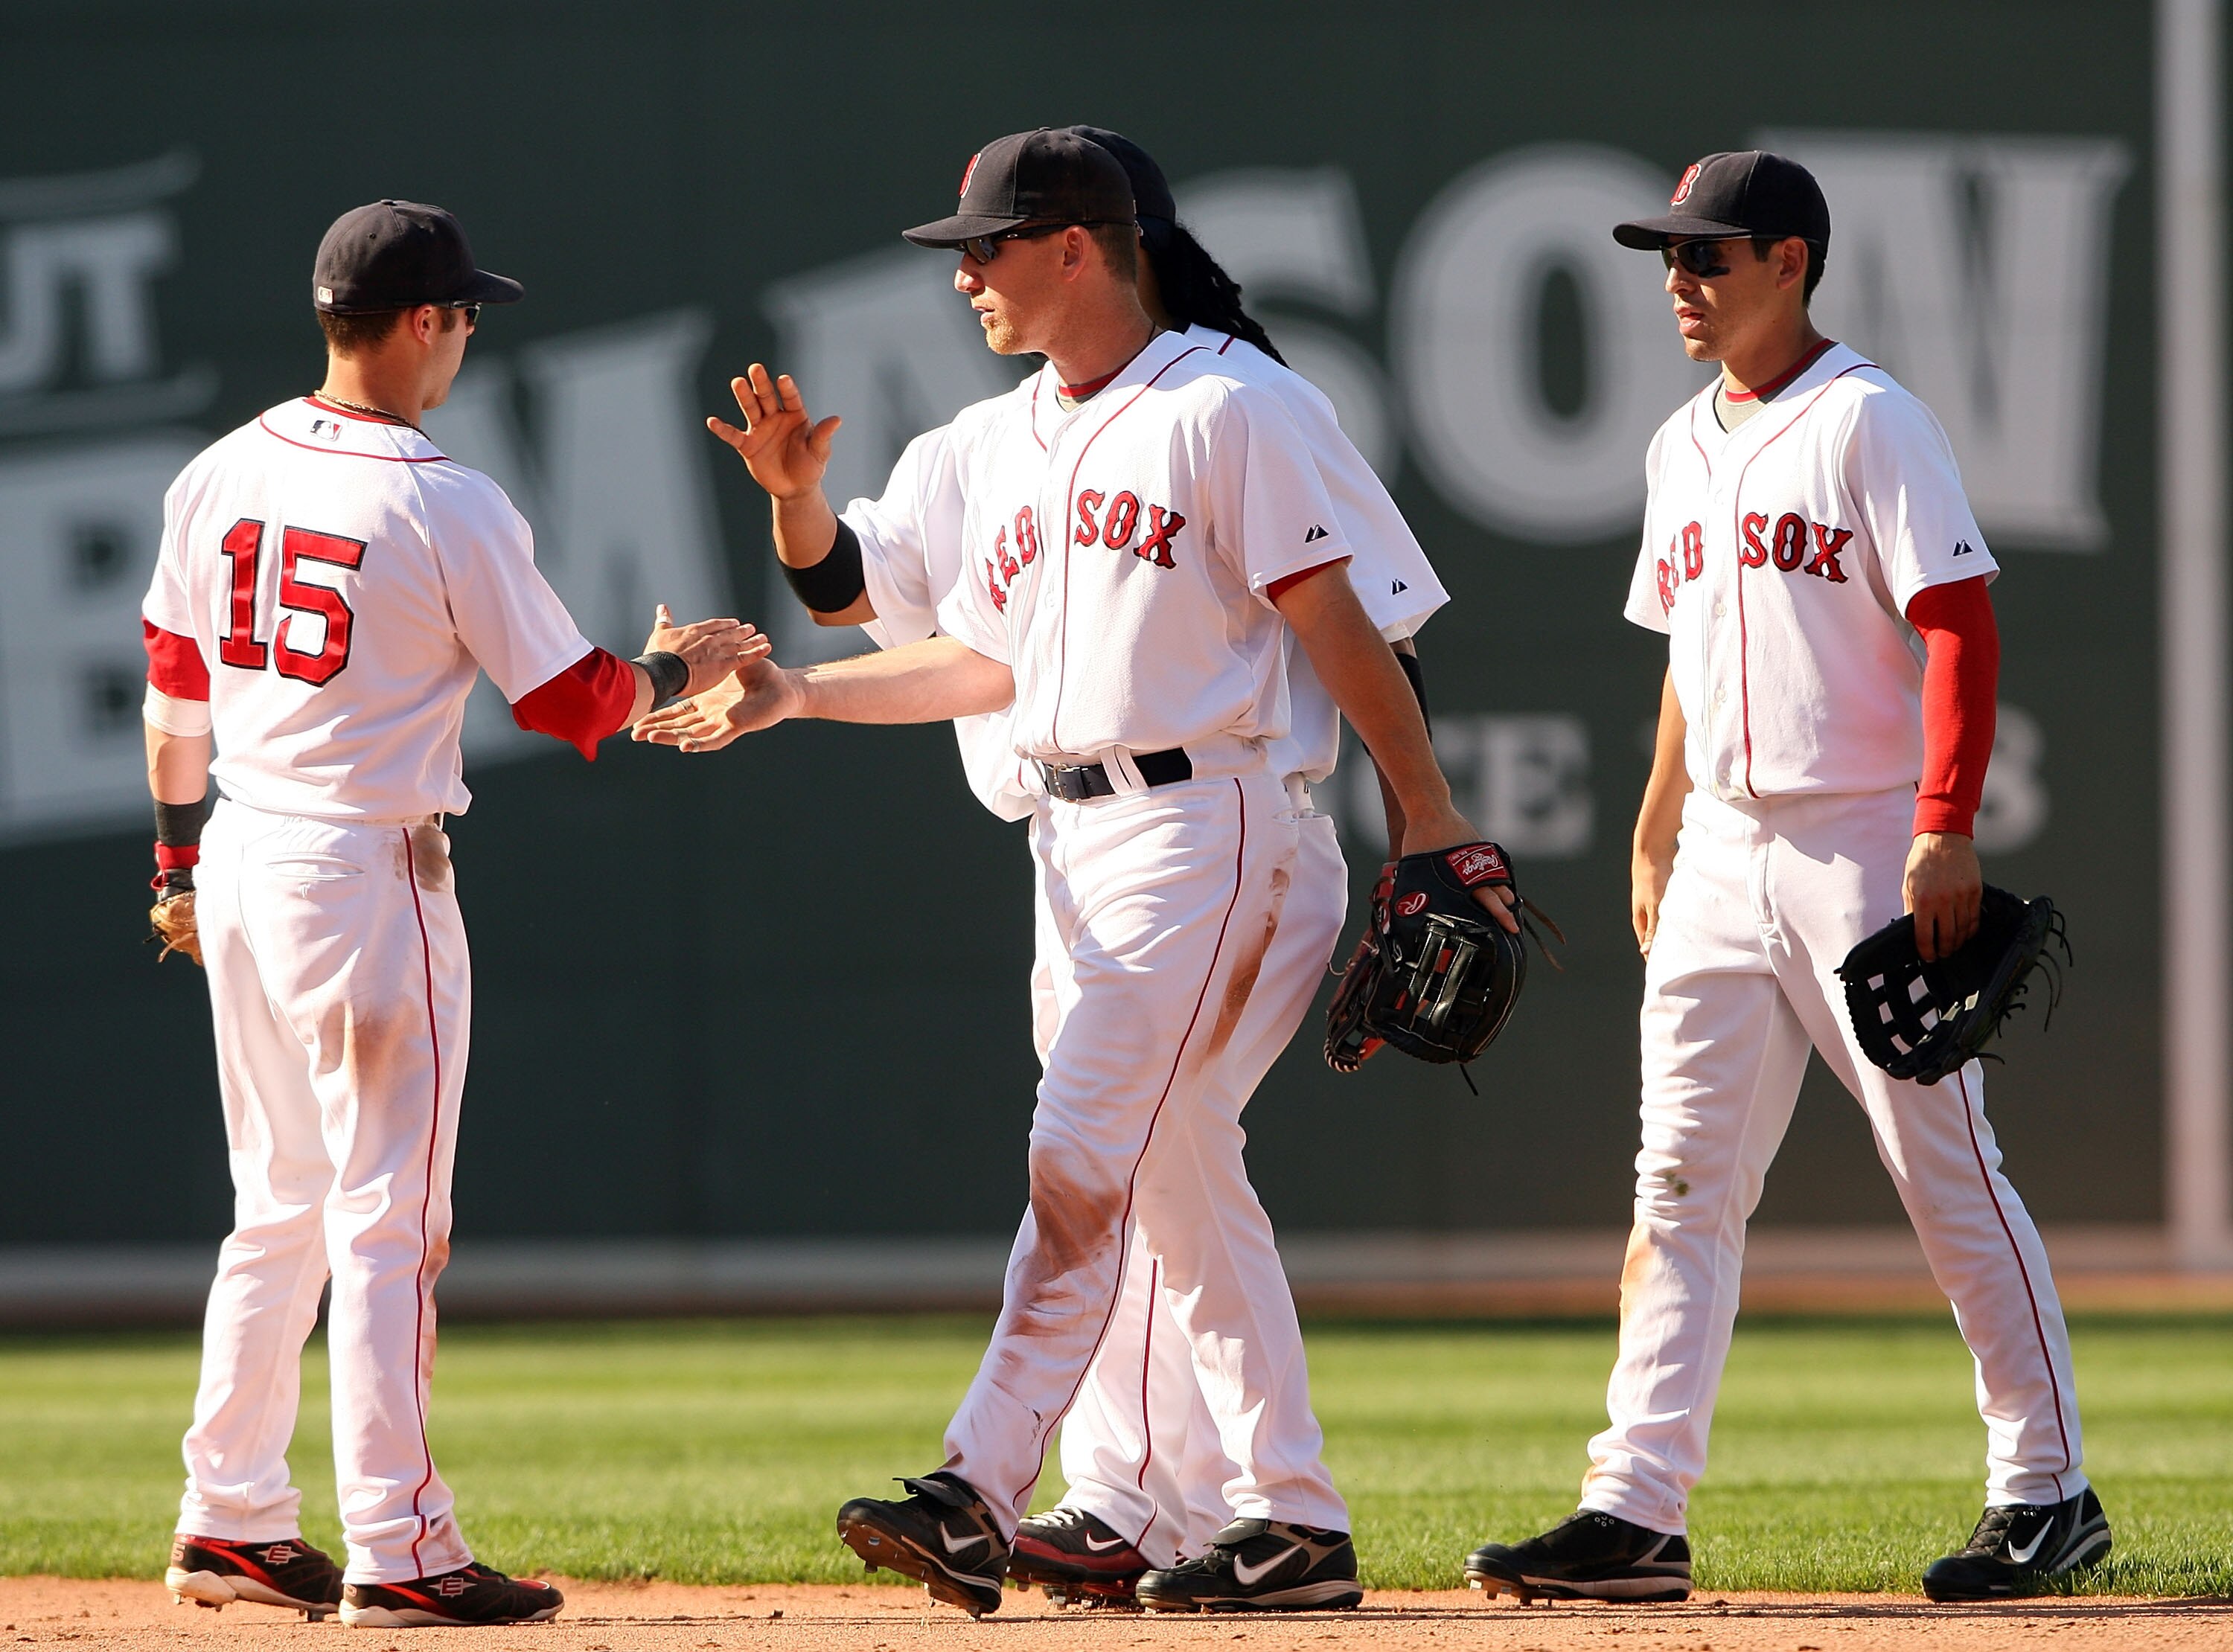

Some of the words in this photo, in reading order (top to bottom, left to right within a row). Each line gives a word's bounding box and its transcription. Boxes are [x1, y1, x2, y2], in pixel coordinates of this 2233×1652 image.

[1670, 163, 1702, 206] B
[1074, 489, 1186, 570] SOX
[1657, 521, 1705, 619] RD
[1740, 512, 1854, 584] SOX
[219, 518, 368, 687] 15
[1462, 854, 1498, 875] Rawlings
[1399, 893, 1427, 915] R
